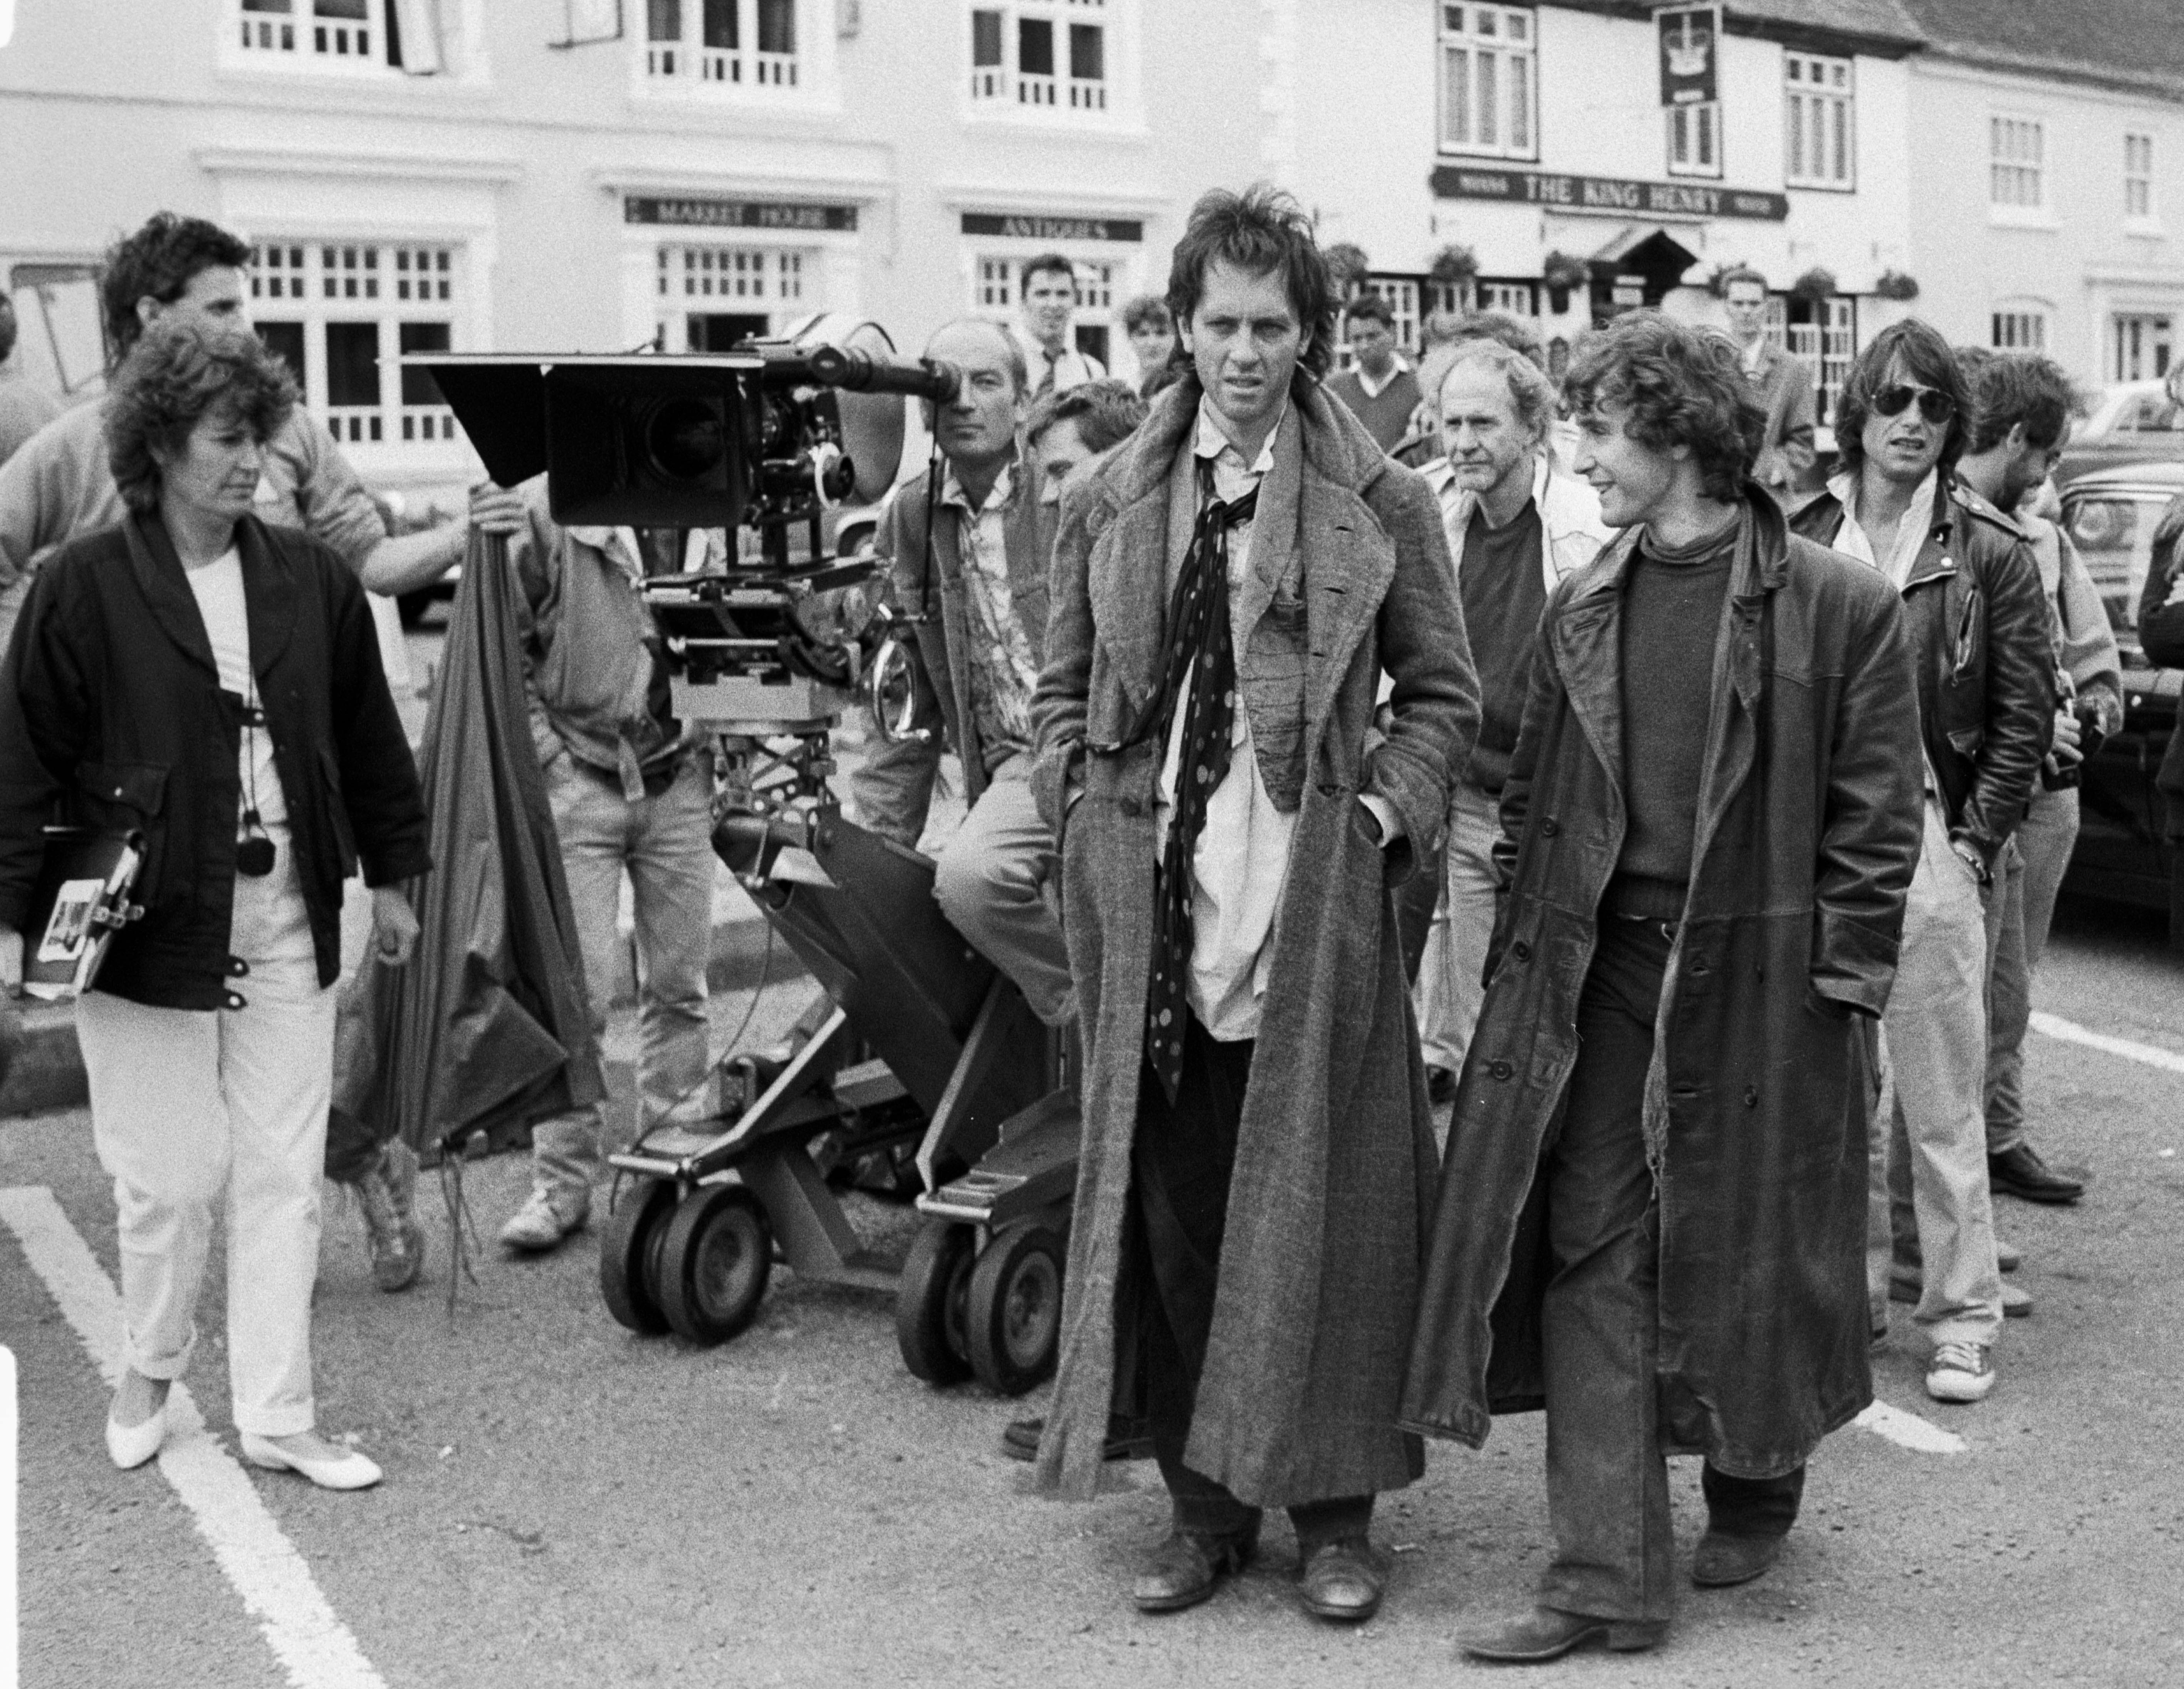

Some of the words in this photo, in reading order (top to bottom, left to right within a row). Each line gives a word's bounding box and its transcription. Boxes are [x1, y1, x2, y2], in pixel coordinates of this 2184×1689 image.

[1524, 175, 1573, 203] THE
[1584, 180, 1639, 208] KING
[1650, 185, 1724, 213] HENRY
